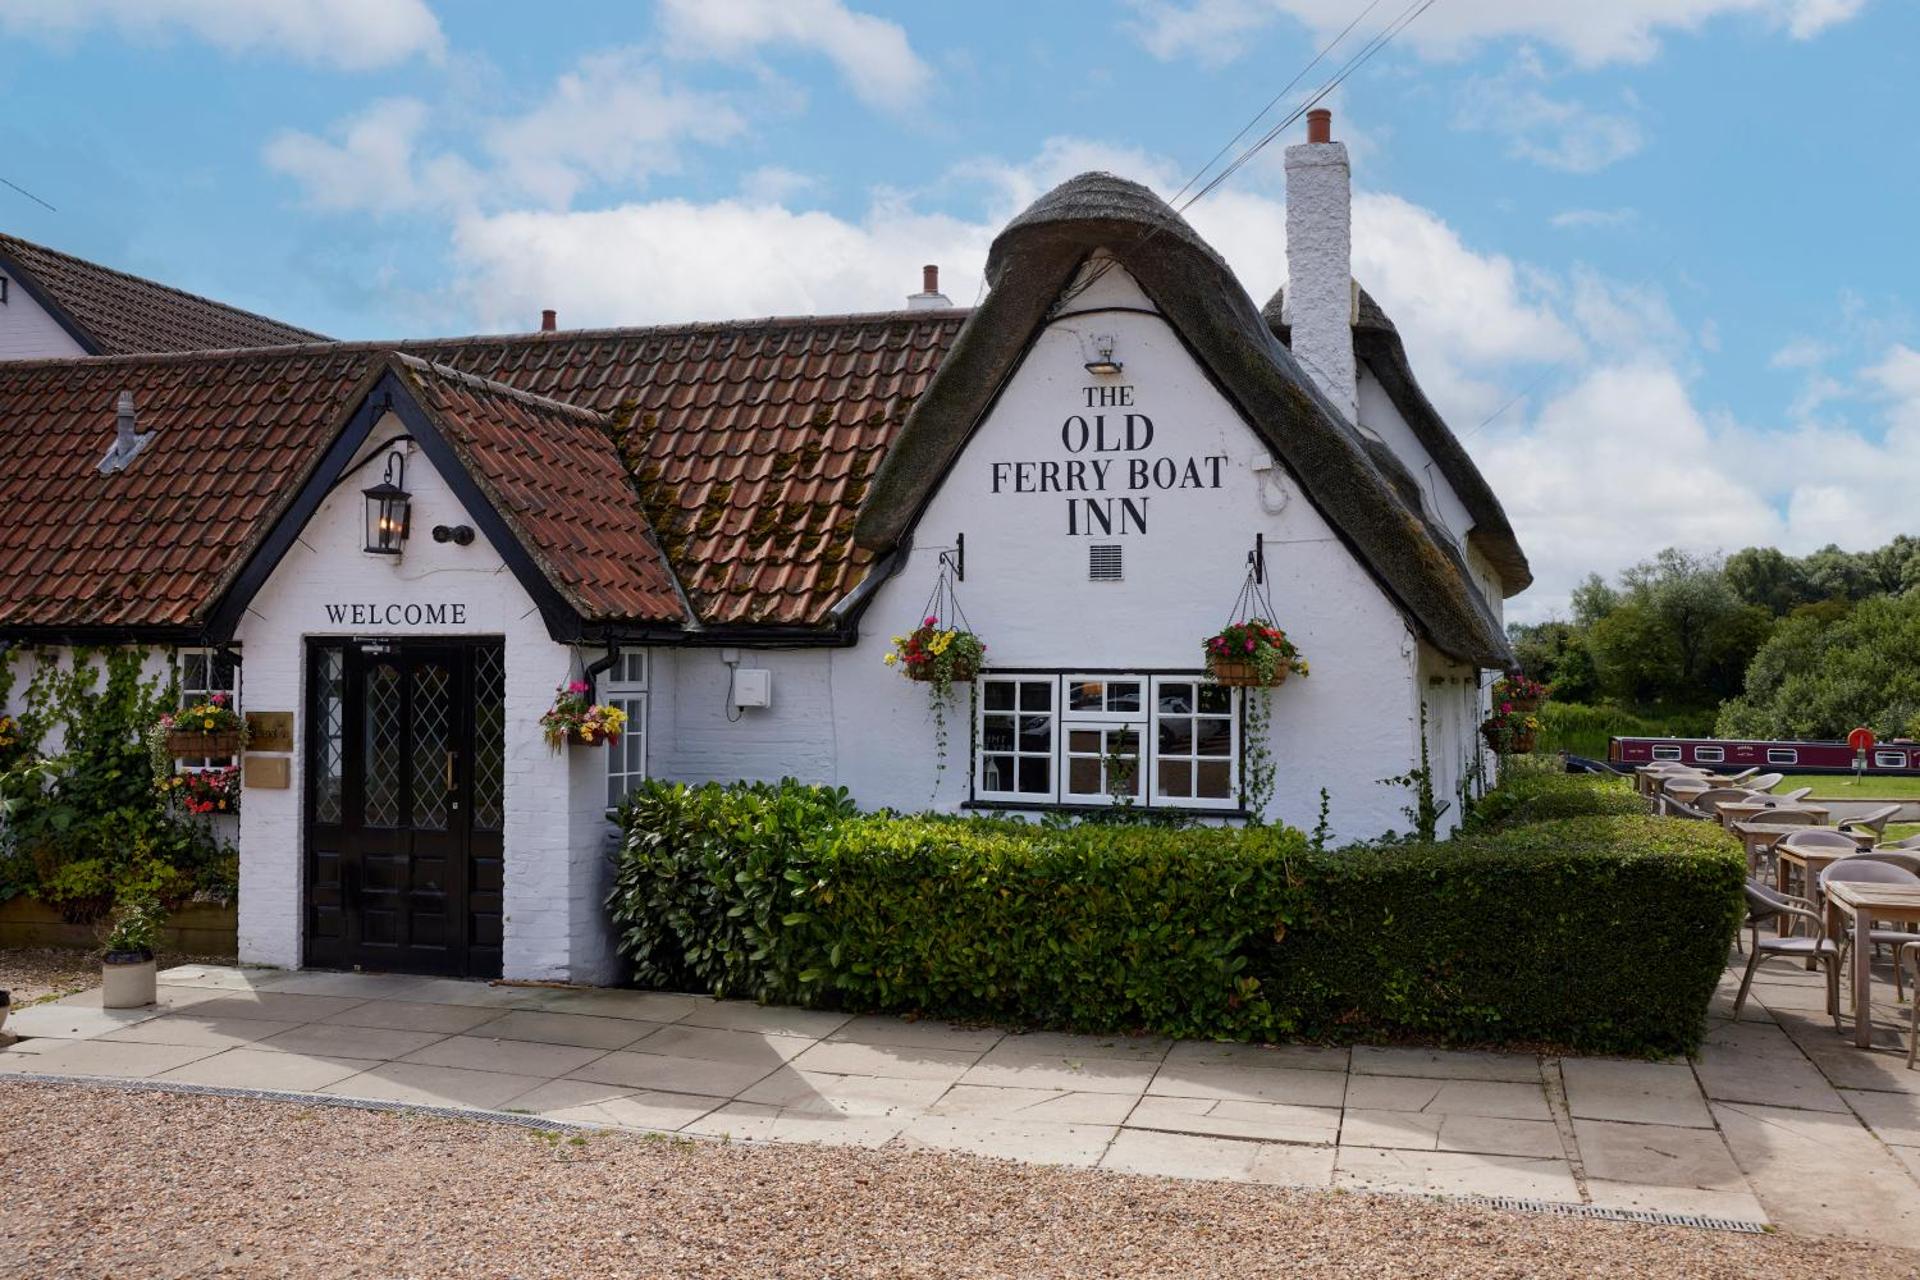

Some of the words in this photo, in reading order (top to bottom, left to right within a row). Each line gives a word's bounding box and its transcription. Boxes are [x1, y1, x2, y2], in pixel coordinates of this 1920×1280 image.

[1082, 385, 1135, 408] THE
[1061, 413, 1154, 454] OLD
[991, 458, 1113, 494] FERRY
[1127, 455, 1229, 490] BOAT
[1065, 496, 1150, 536] INN
[324, 603, 467, 626] WELCOME
